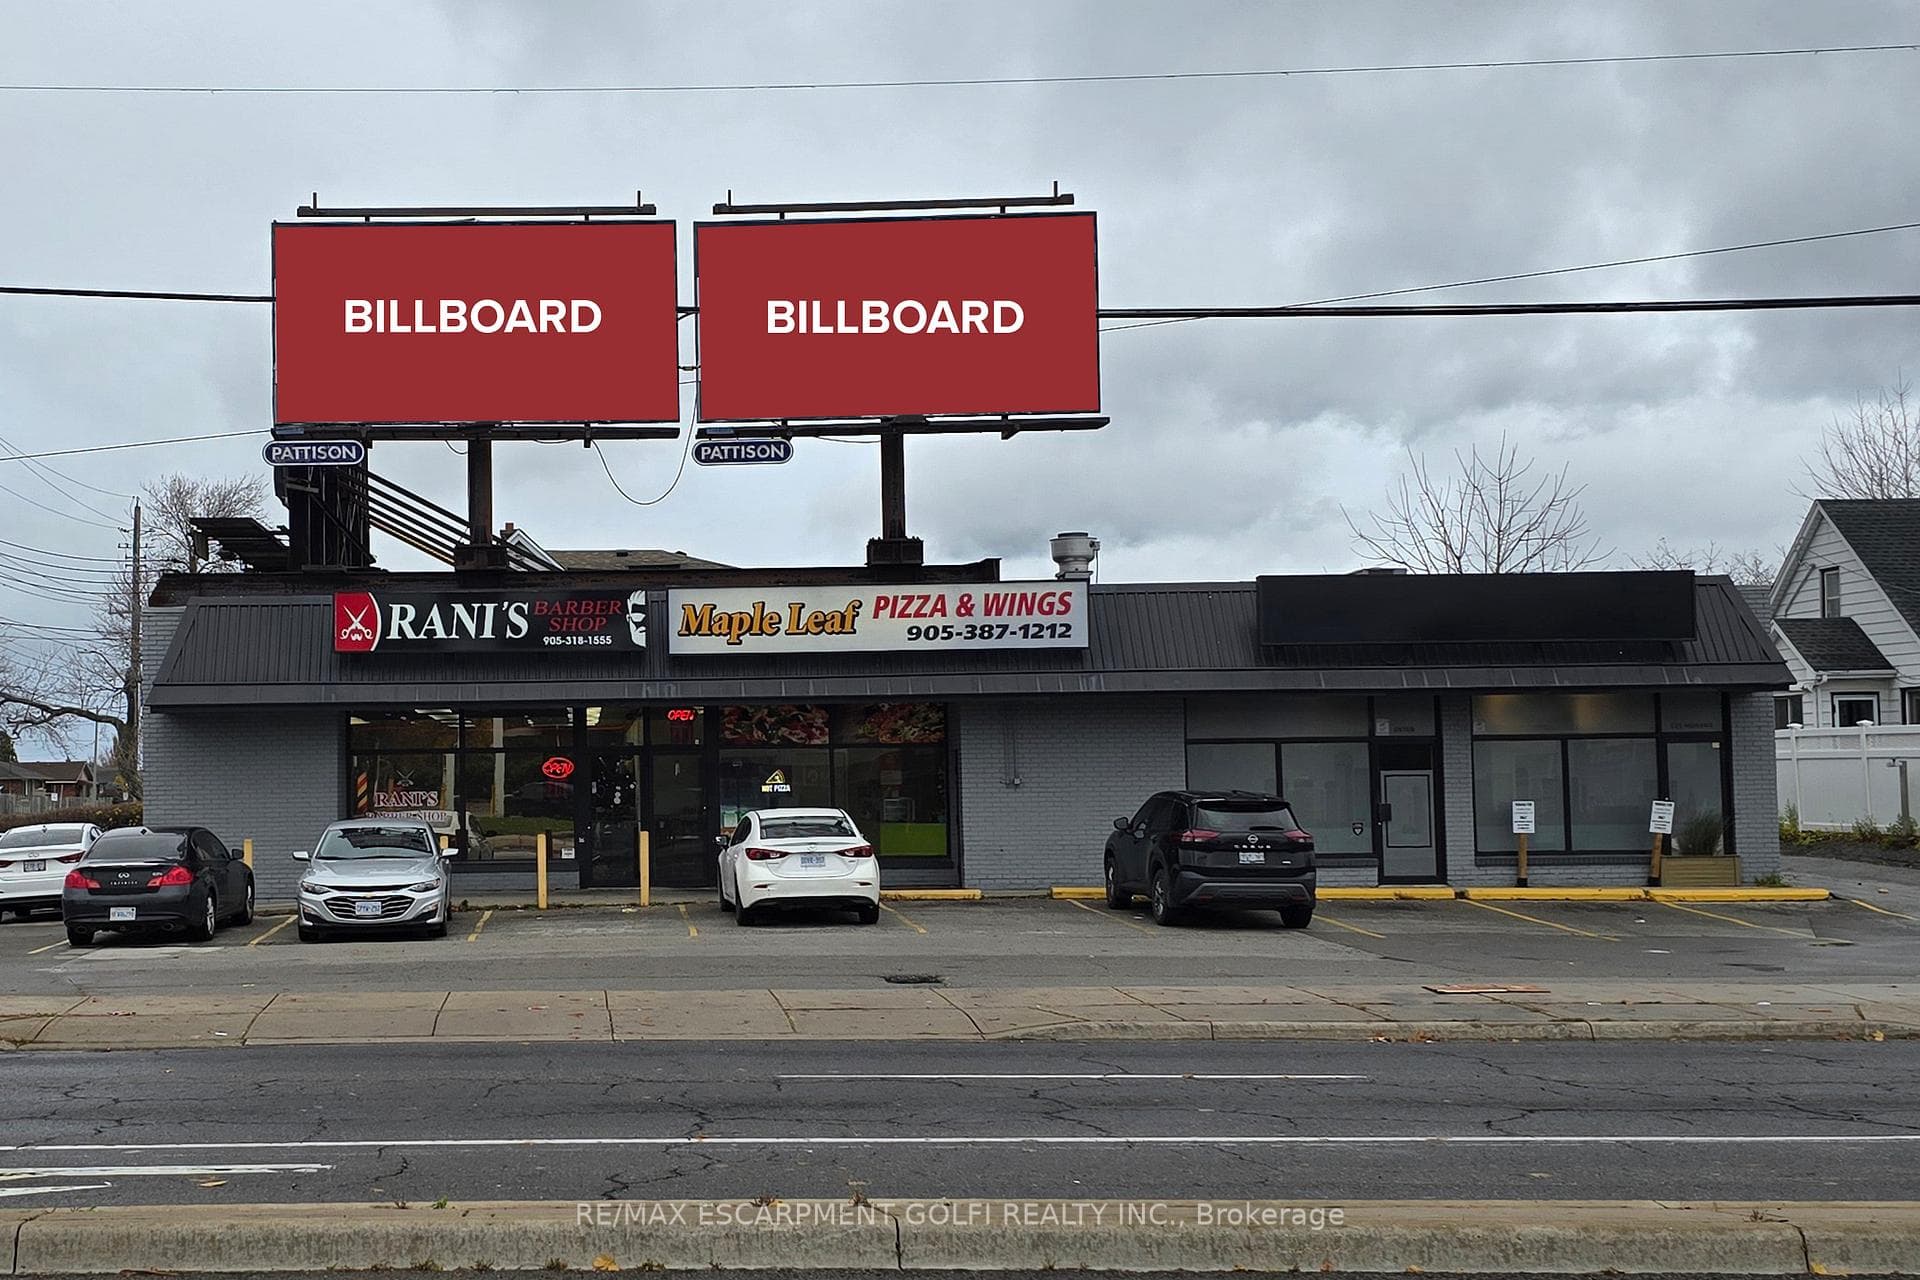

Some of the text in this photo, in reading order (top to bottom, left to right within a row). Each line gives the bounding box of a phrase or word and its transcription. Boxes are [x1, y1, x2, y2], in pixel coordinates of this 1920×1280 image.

[344, 298, 602, 334] BILLBOARD
[767, 299, 1025, 335] BILLBOARD
[271, 445, 357, 460] PATTISON
[701, 444, 785, 460] PATTISON
[534, 600, 623, 616] BARBER
[873, 592, 1072, 619] PIZZA & WINGS
[385, 601, 529, 639] RANI'S
[549, 616, 608, 632] SHOP
[677, 599, 864, 645] Maple Leaf
[542, 635, 613, 646] 905-318-1555
[906, 622, 1073, 642] 905-387-1212
[667, 709, 695, 721] OPEN
[374, 790, 440, 808] RANI'S
